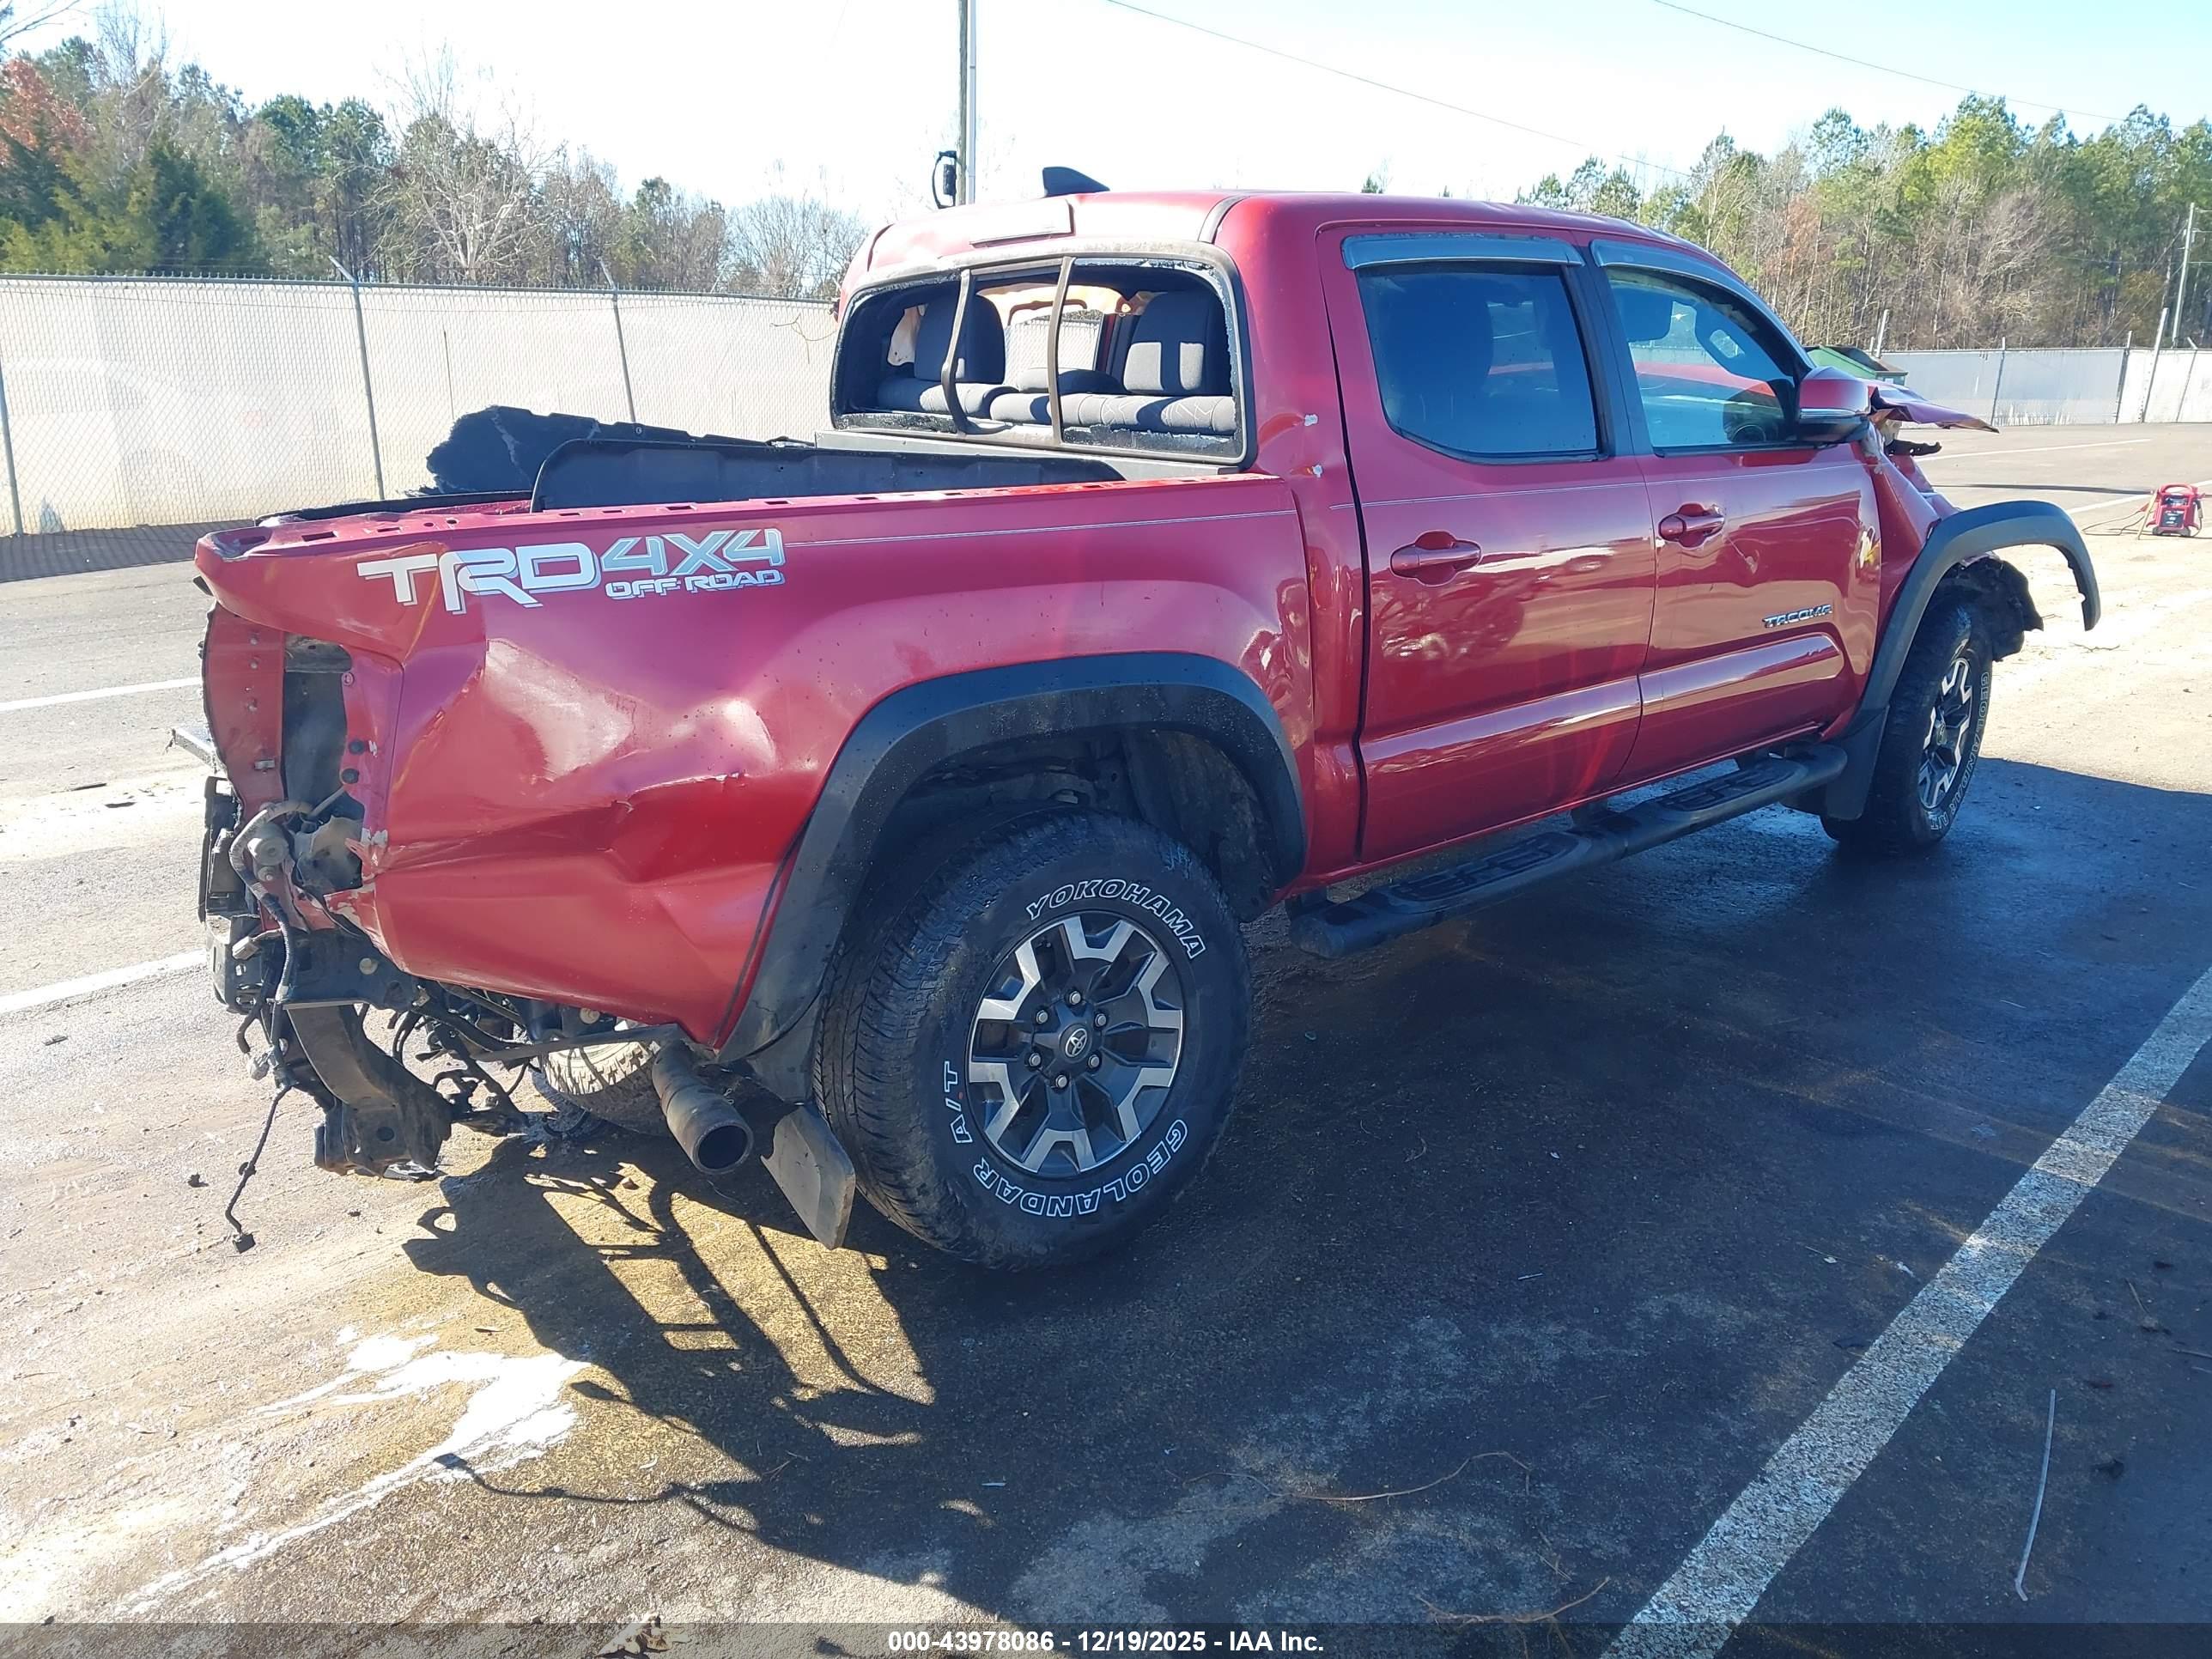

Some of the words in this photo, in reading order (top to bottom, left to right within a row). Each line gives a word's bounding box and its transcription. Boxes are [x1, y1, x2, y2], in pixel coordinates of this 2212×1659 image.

[356, 542, 600, 615] TRD
[601, 527, 787, 578] 4X4
[605, 579, 683, 600] OFF
[685, 569, 787, 593] ROAD
[1762, 604, 1832, 629] TACOMA
[1025, 878, 1206, 960] YOKOHAMA
[944, 1060, 973, 1144] A/T
[972, 1118, 1188, 1218] GEOLANDAR
